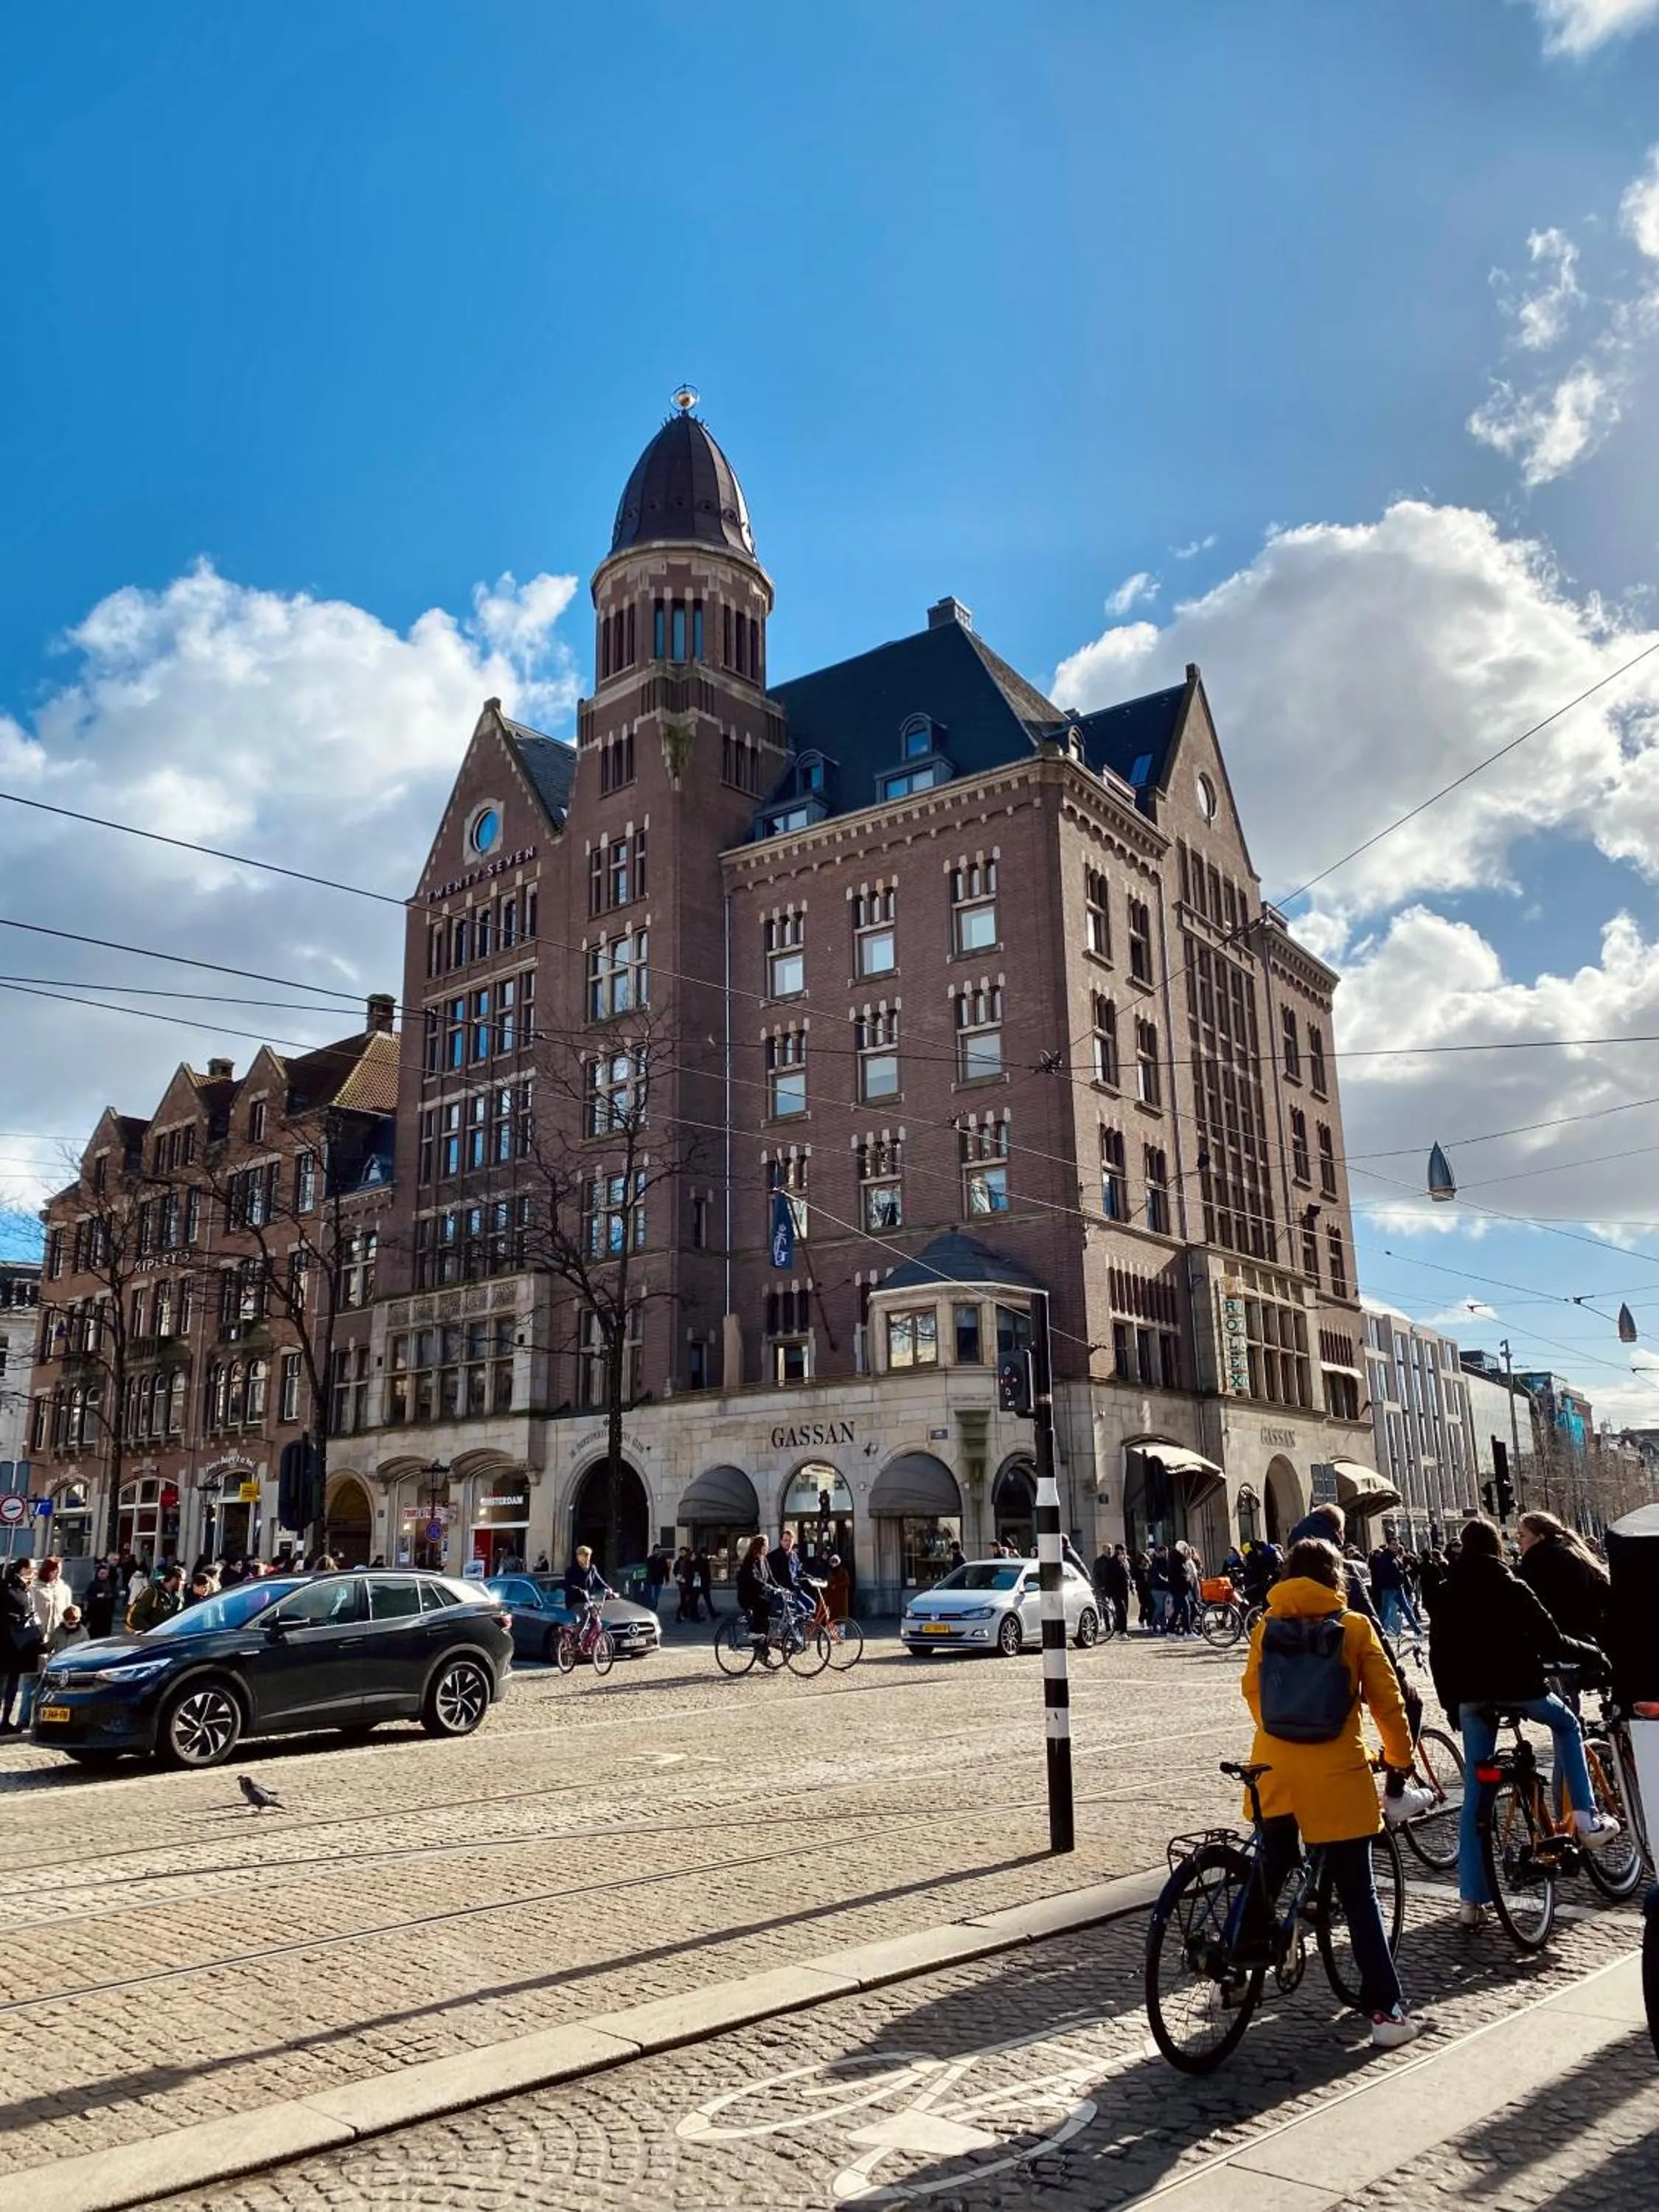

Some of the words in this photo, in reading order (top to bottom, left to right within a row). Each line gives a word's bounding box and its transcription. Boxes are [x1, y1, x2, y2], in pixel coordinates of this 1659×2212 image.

[426, 869, 483, 903] TWENTY
[487, 845, 536, 877] SEVEN
[1225, 1300, 1242, 1388] ROLEX
[771, 1421, 856, 1449] GASSAN
[1260, 1427, 1295, 1447] GASSAN
